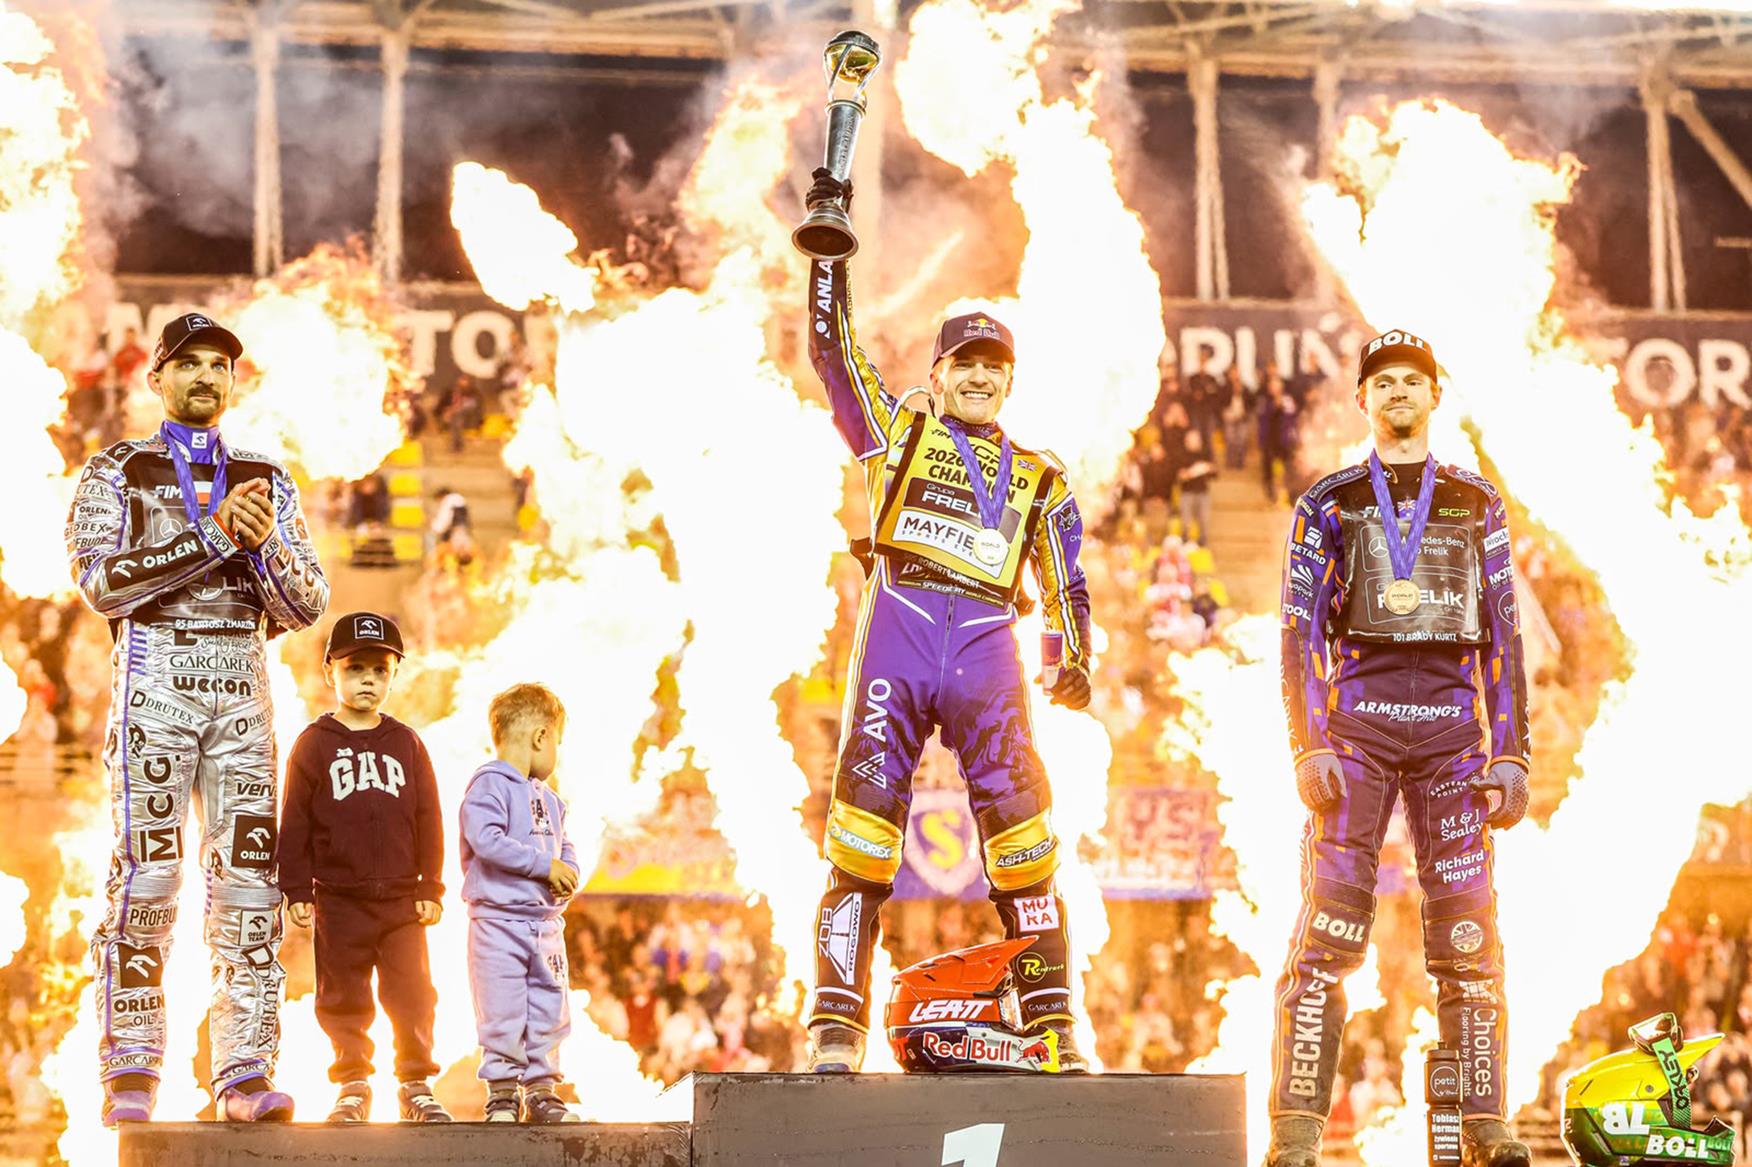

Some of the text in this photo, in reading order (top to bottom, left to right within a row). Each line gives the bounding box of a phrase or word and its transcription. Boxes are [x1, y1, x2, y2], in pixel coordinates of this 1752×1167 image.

[1438, 508, 1470, 518] SGP
[142, 540, 198, 569] ORLEN
[169, 655, 255, 673] GARCAREK
[863, 678, 892, 743] AVO
[1353, 700, 1462, 718] ARMSTRONG'S
[328, 750, 406, 801] GAP
[1441, 808, 1480, 831] M & J
[1441, 822, 1484, 842] Sealey
[1435, 849, 1485, 873] Richard
[1442, 865, 1482, 884] Hayes
[1312, 911, 1366, 943] BOLL
[113, 996, 165, 1013] ORLEN
[909, 1000, 993, 1022] LEATT
[132, 1014, 154, 1026] OIL
[1460, 1007, 1471, 1046] Flooring
[923, 1031, 969, 1059] Red
[970, 1038, 1012, 1062] Bull
[1473, 1008, 1497, 1096] Choices
[1434, 1077, 1455, 1090] petit
[1646, 1134, 1708, 1159] BOLL
